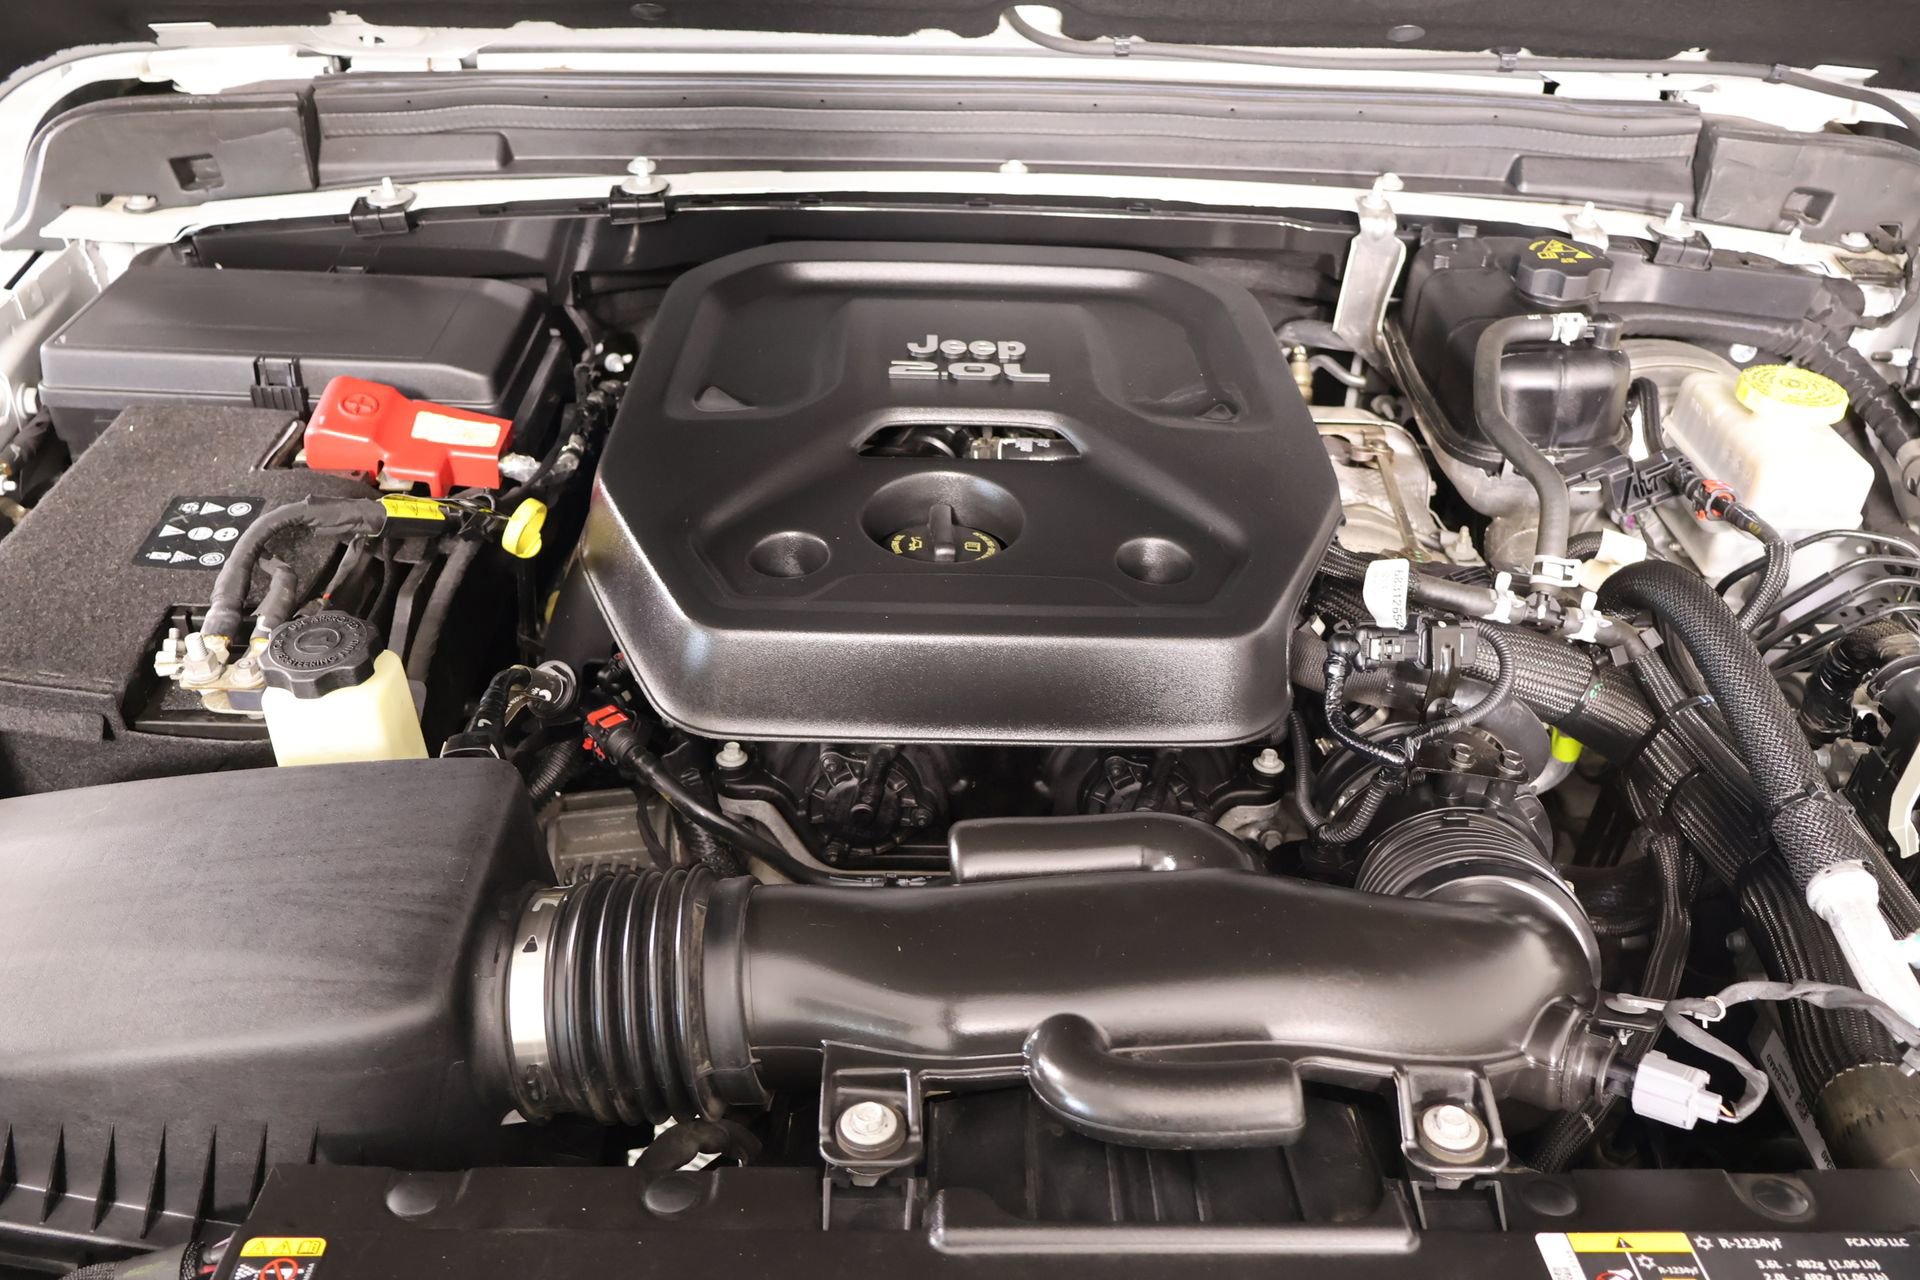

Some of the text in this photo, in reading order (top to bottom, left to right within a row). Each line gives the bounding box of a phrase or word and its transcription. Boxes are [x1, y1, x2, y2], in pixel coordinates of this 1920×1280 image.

[907, 334, 1026, 362] Jeep
[888, 360, 1050, 382] 2.0L
[1717, 1237, 1783, 1251] R-1234yf
[1845, 1237, 1910, 1247] FCA US LLC
[1755, 1259, 1783, 1270] 3.6L
